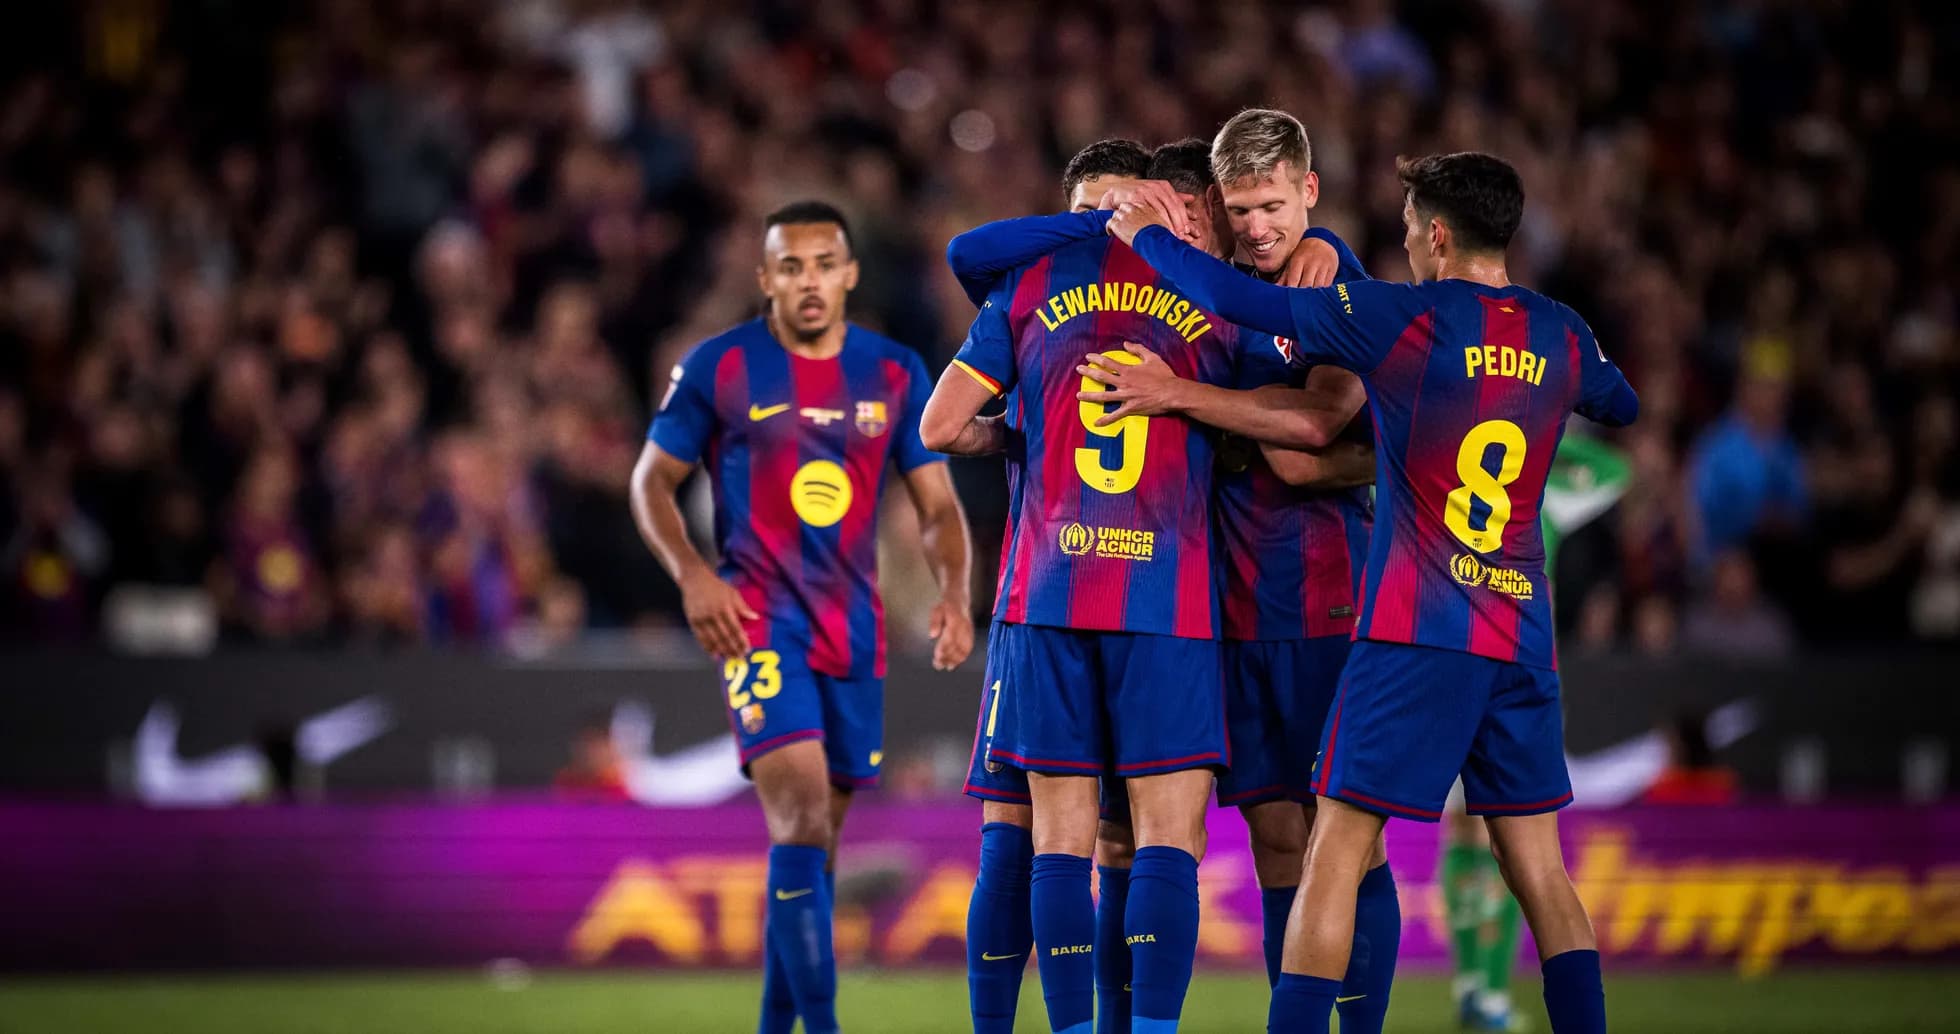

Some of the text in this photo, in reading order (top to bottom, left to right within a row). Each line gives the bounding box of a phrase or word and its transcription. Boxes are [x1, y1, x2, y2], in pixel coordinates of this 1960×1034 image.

[1036, 282, 1212, 344] LEWANDOWSKI
[1464, 345, 1547, 386] PEDRI
[1074, 350, 1150, 494] 9
[1444, 419, 1527, 554] 8
[1096, 540, 1153, 556] ACNUR
[1097, 527, 1154, 544] UNHCR
[724, 650, 782, 709] 23
